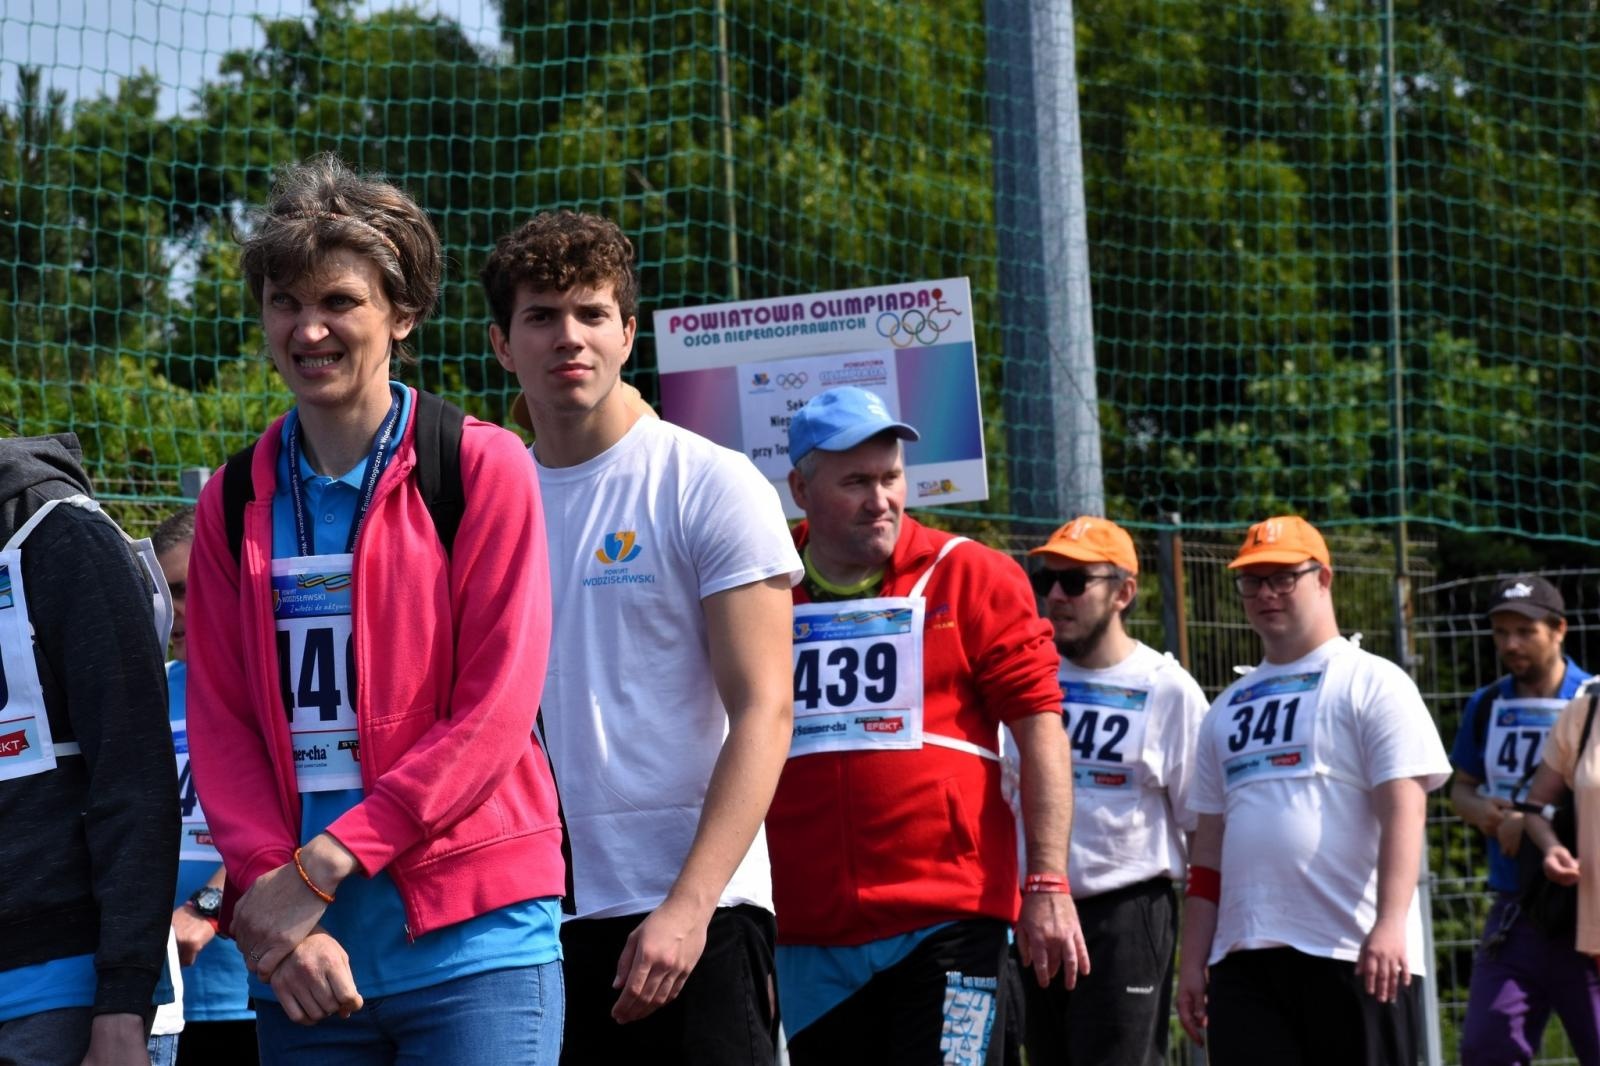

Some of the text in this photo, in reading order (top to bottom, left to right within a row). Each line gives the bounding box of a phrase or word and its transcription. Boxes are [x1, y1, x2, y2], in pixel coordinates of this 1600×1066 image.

[669, 288, 930, 334] POWIATOWA OLIMPIADA
[683, 317, 867, 347] OSÓB NIEPEŁNOSPRAWNYCH
[582, 574, 656, 587] WODZISŁAWSKI
[793, 642, 898, 710] 439
[866, 722, 898, 731] EFEKT
[1228, 696, 1300, 753] 341
[0, 739, 20, 753] KT
[1497, 730, 1549, 773] 47
